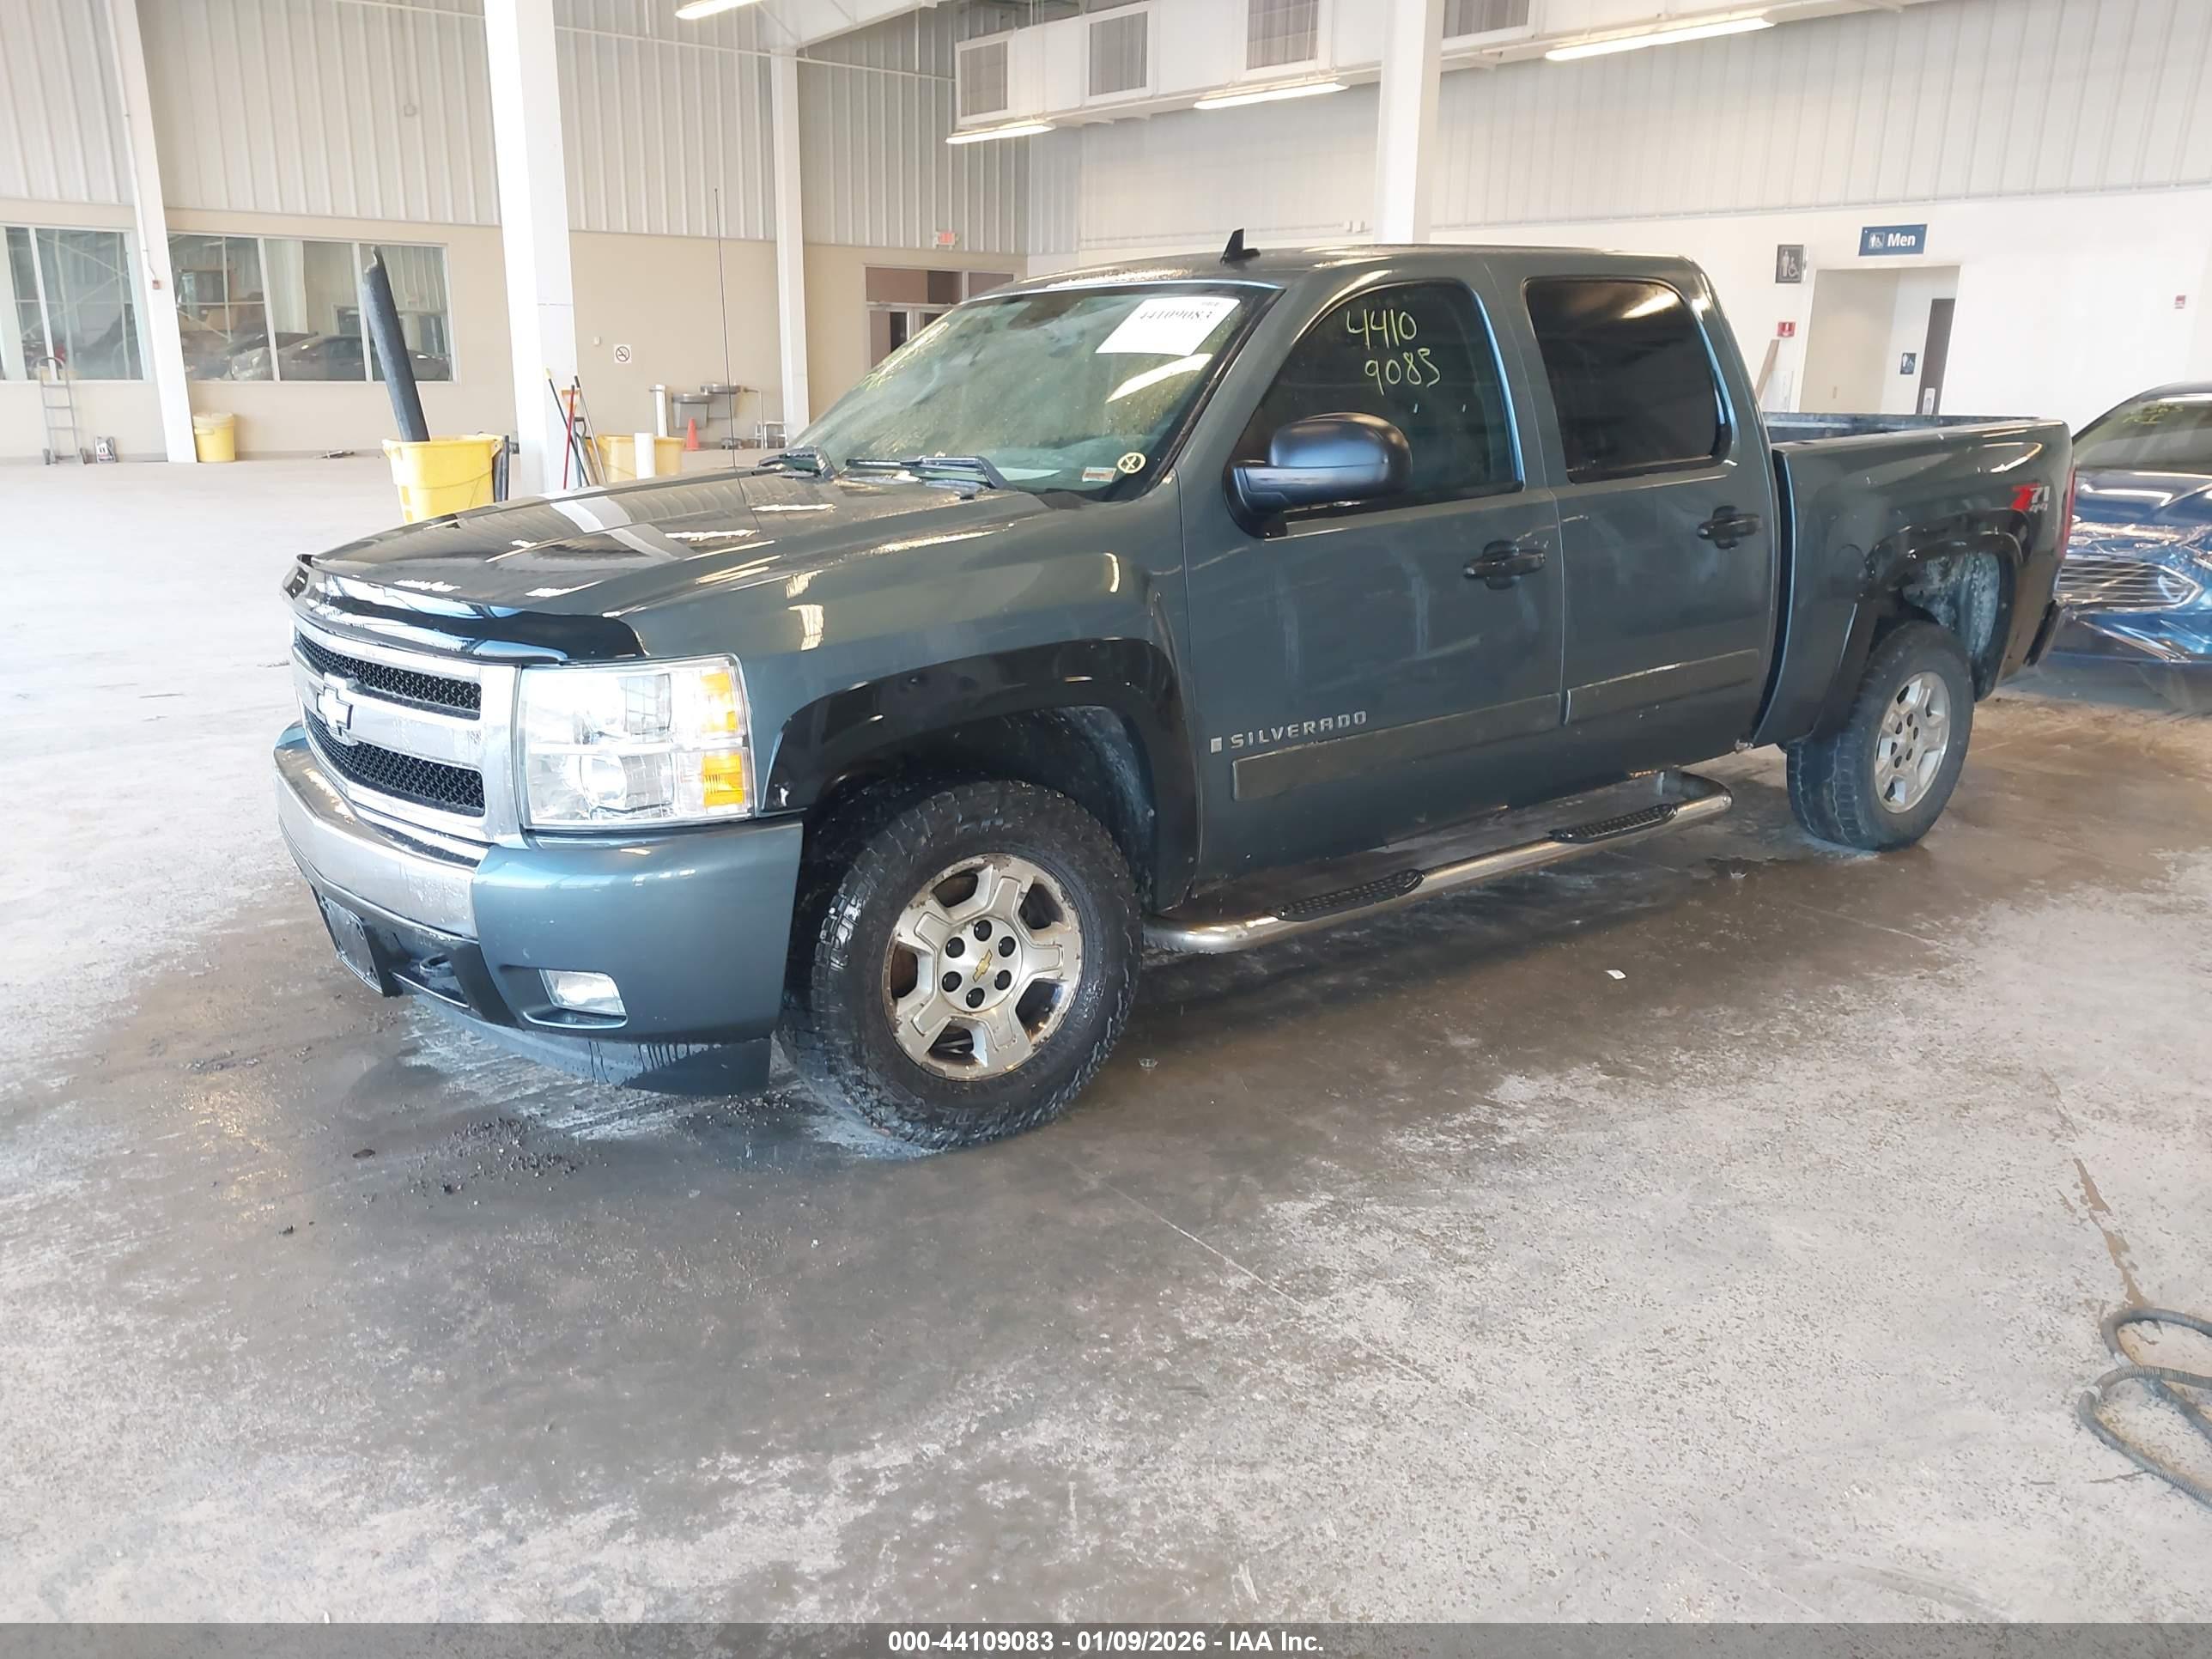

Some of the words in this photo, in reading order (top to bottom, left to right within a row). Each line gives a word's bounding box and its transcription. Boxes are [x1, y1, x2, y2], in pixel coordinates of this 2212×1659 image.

[1887, 232, 1916, 247] Men
[1346, 308, 1418, 350] 4410
[1231, 710, 1367, 750] SILVERADO
